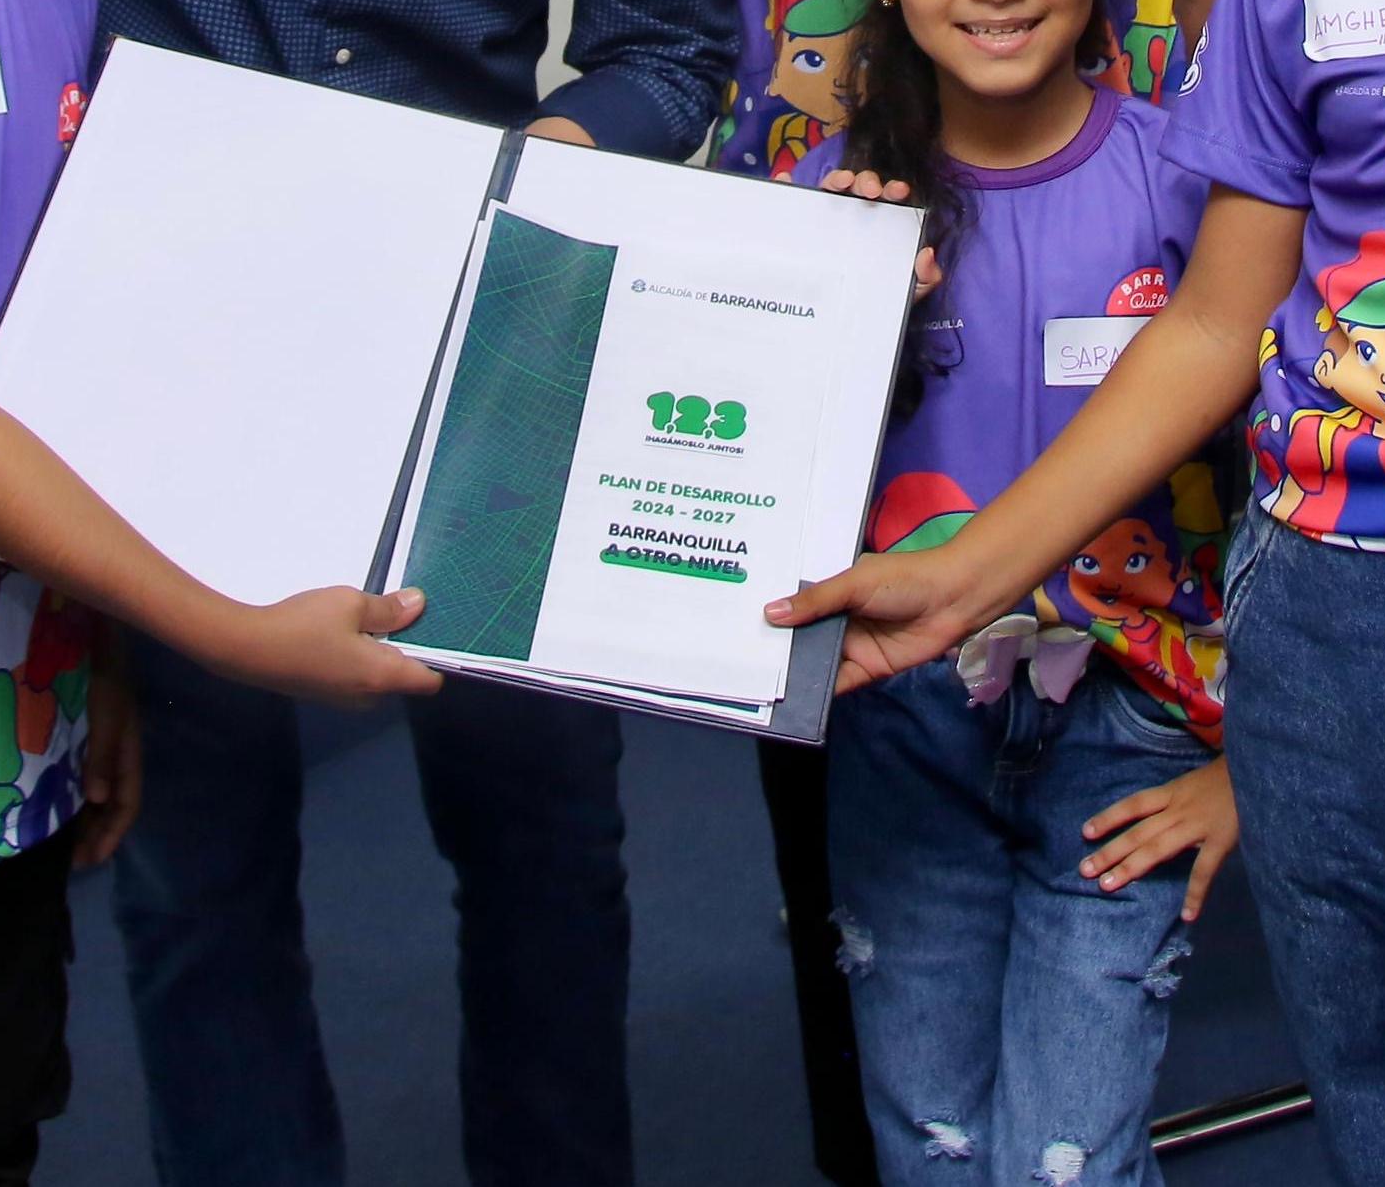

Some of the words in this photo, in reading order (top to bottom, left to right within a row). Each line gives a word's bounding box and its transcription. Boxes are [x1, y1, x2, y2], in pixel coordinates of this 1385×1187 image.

[649, 283, 693, 299] ALCALDÍA
[695, 291, 708, 301] DE
[710, 291, 816, 319] BARRANQUILLA
[1120, 273, 1164, 296] BARR
[599, 473, 642, 491] PLAN
[645, 480, 667, 494] DE
[671, 484, 776, 508] DESARROLLO
[632, 499, 675, 517] 2024
[692, 508, 736, 524] 2027
[608, 522, 748, 555] BARRANQUILLA
[606, 543, 621, 559] A
[626, 545, 683, 567] OTRO
[688, 554, 745, 576] NIVEL
